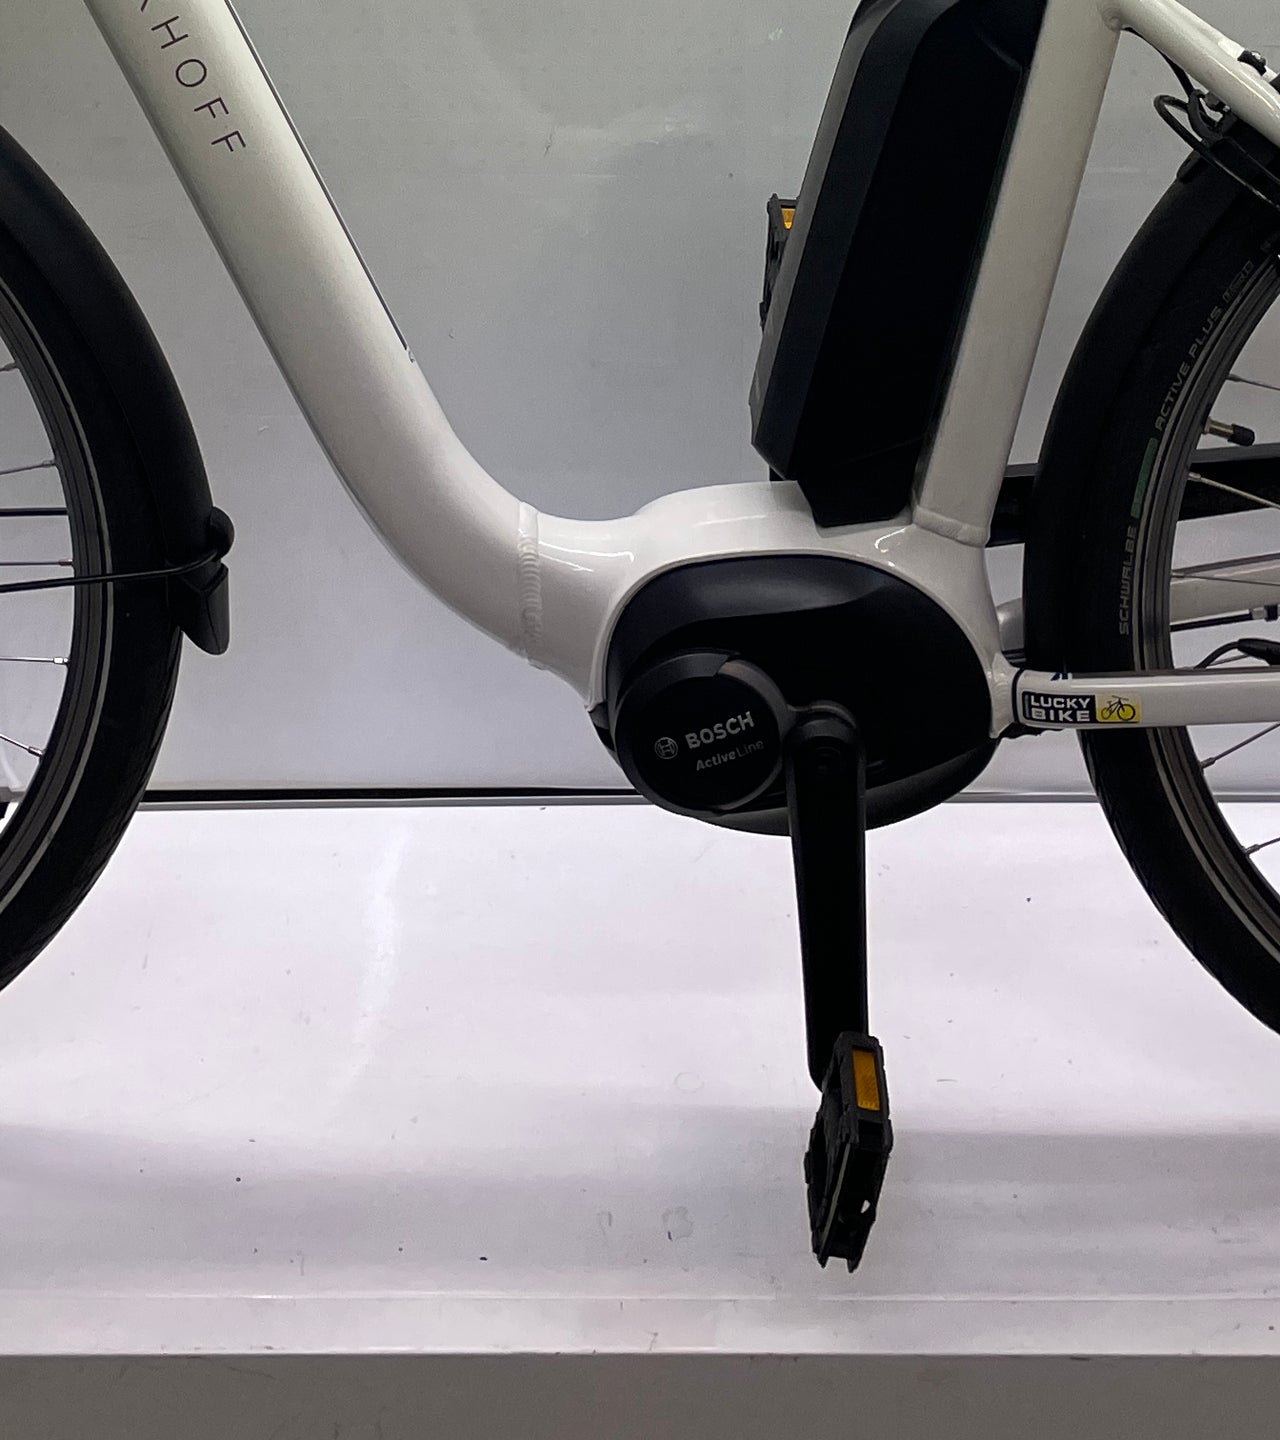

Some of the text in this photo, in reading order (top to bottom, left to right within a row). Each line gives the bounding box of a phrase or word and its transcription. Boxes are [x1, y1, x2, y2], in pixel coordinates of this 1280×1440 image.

[1118, 305, 1221, 637] SCHWALBE ACTIVE PLUS
[1030, 695, 1091, 709] LUCKY
[1031, 709, 1091, 722] BIKE
[685, 711, 755, 749] BOSCH
